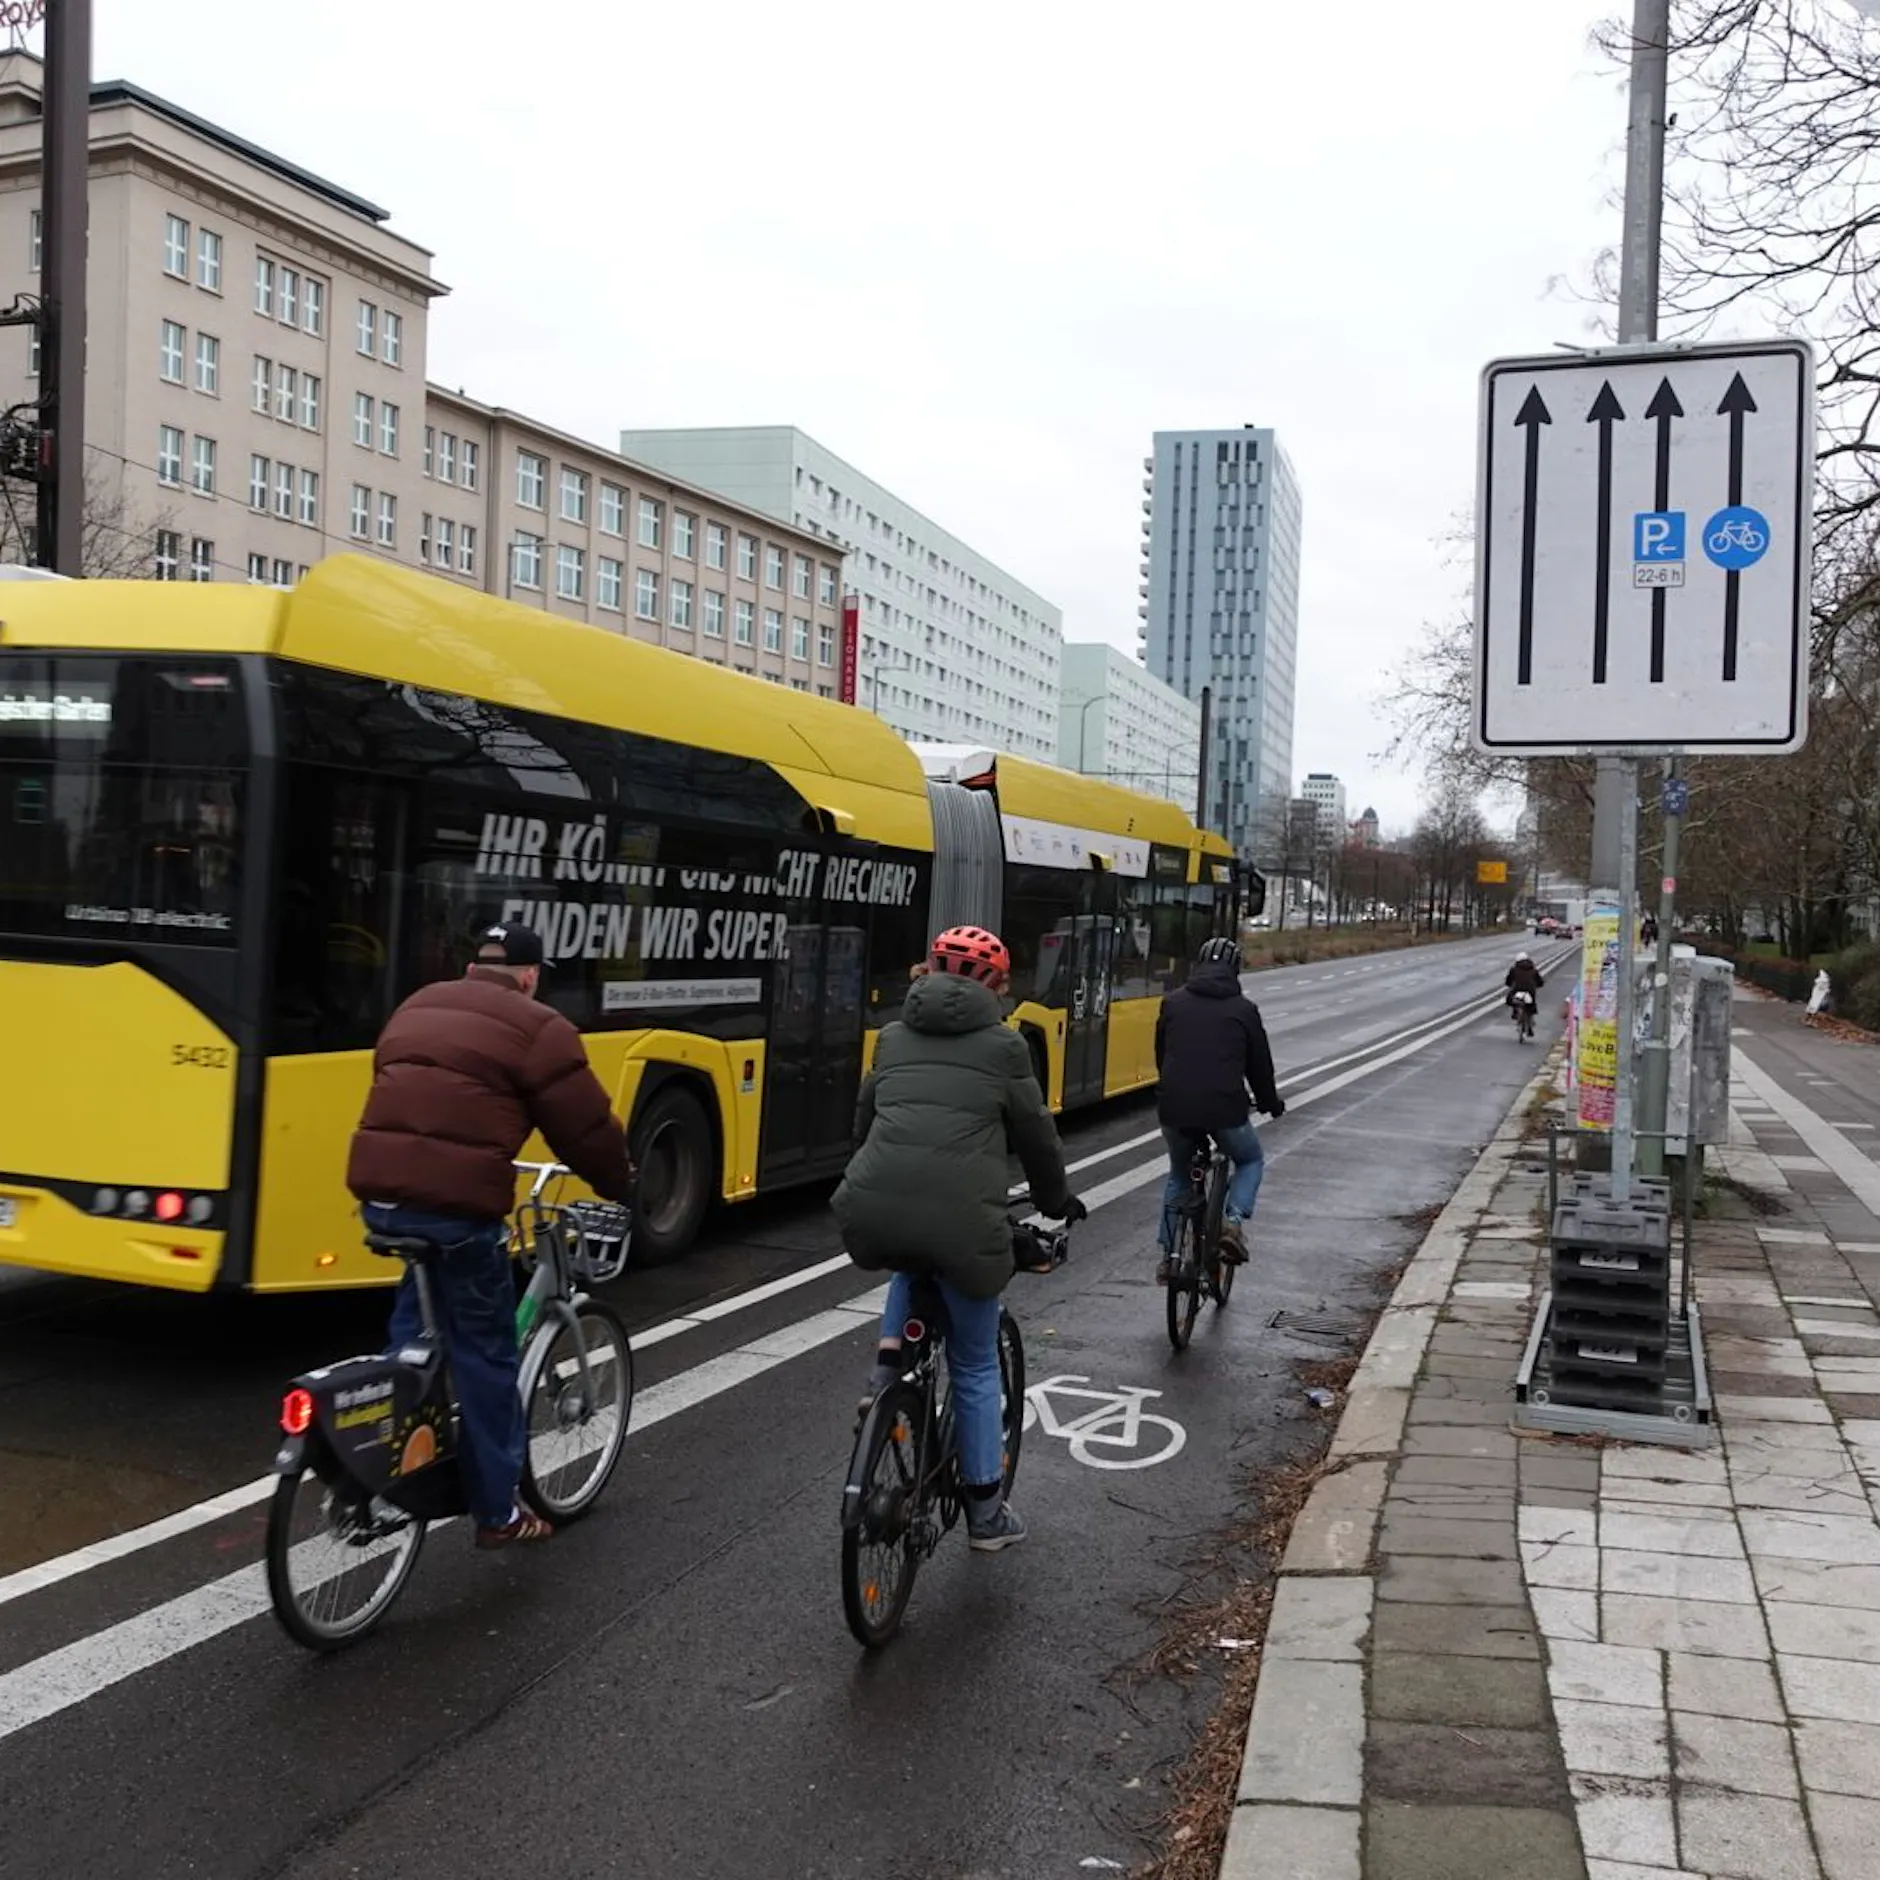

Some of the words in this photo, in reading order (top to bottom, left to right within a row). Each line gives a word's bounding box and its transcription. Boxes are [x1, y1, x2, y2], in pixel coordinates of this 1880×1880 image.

[1642, 518, 1670, 556] P
[1637, 568, 1668, 583] 22-6
[1672, 569, 1680, 581] h
[475, 813, 548, 878] IHR
[822, 856, 917, 906] RIECHEN?
[640, 905, 699, 960] WIR
[703, 908, 790, 960] SUPER.
[171, 1044, 228, 1069] 5432
